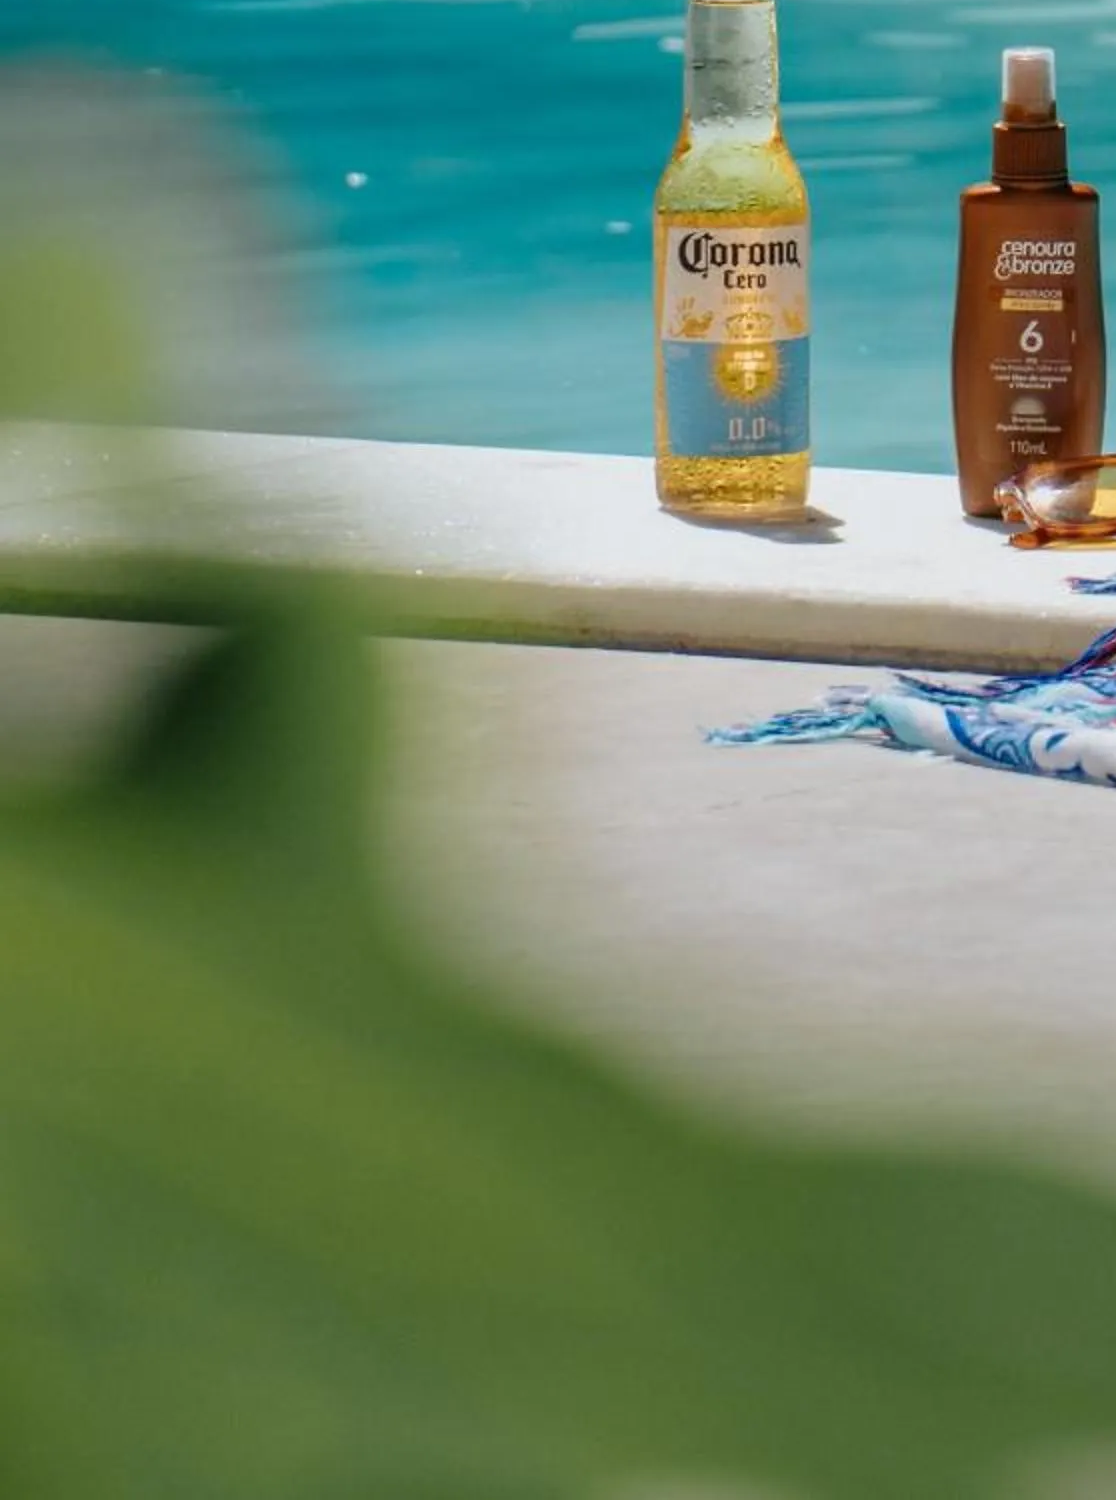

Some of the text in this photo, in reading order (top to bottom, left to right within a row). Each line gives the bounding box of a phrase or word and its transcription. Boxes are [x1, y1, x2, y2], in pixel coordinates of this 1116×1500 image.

[678, 231, 801, 279] Corona
[1002, 241, 1076, 257] cenoura
[723, 270, 767, 289] Cero
[1020, 320, 1044, 353] 6
[1010, 439, 1048, 455] 110mL
